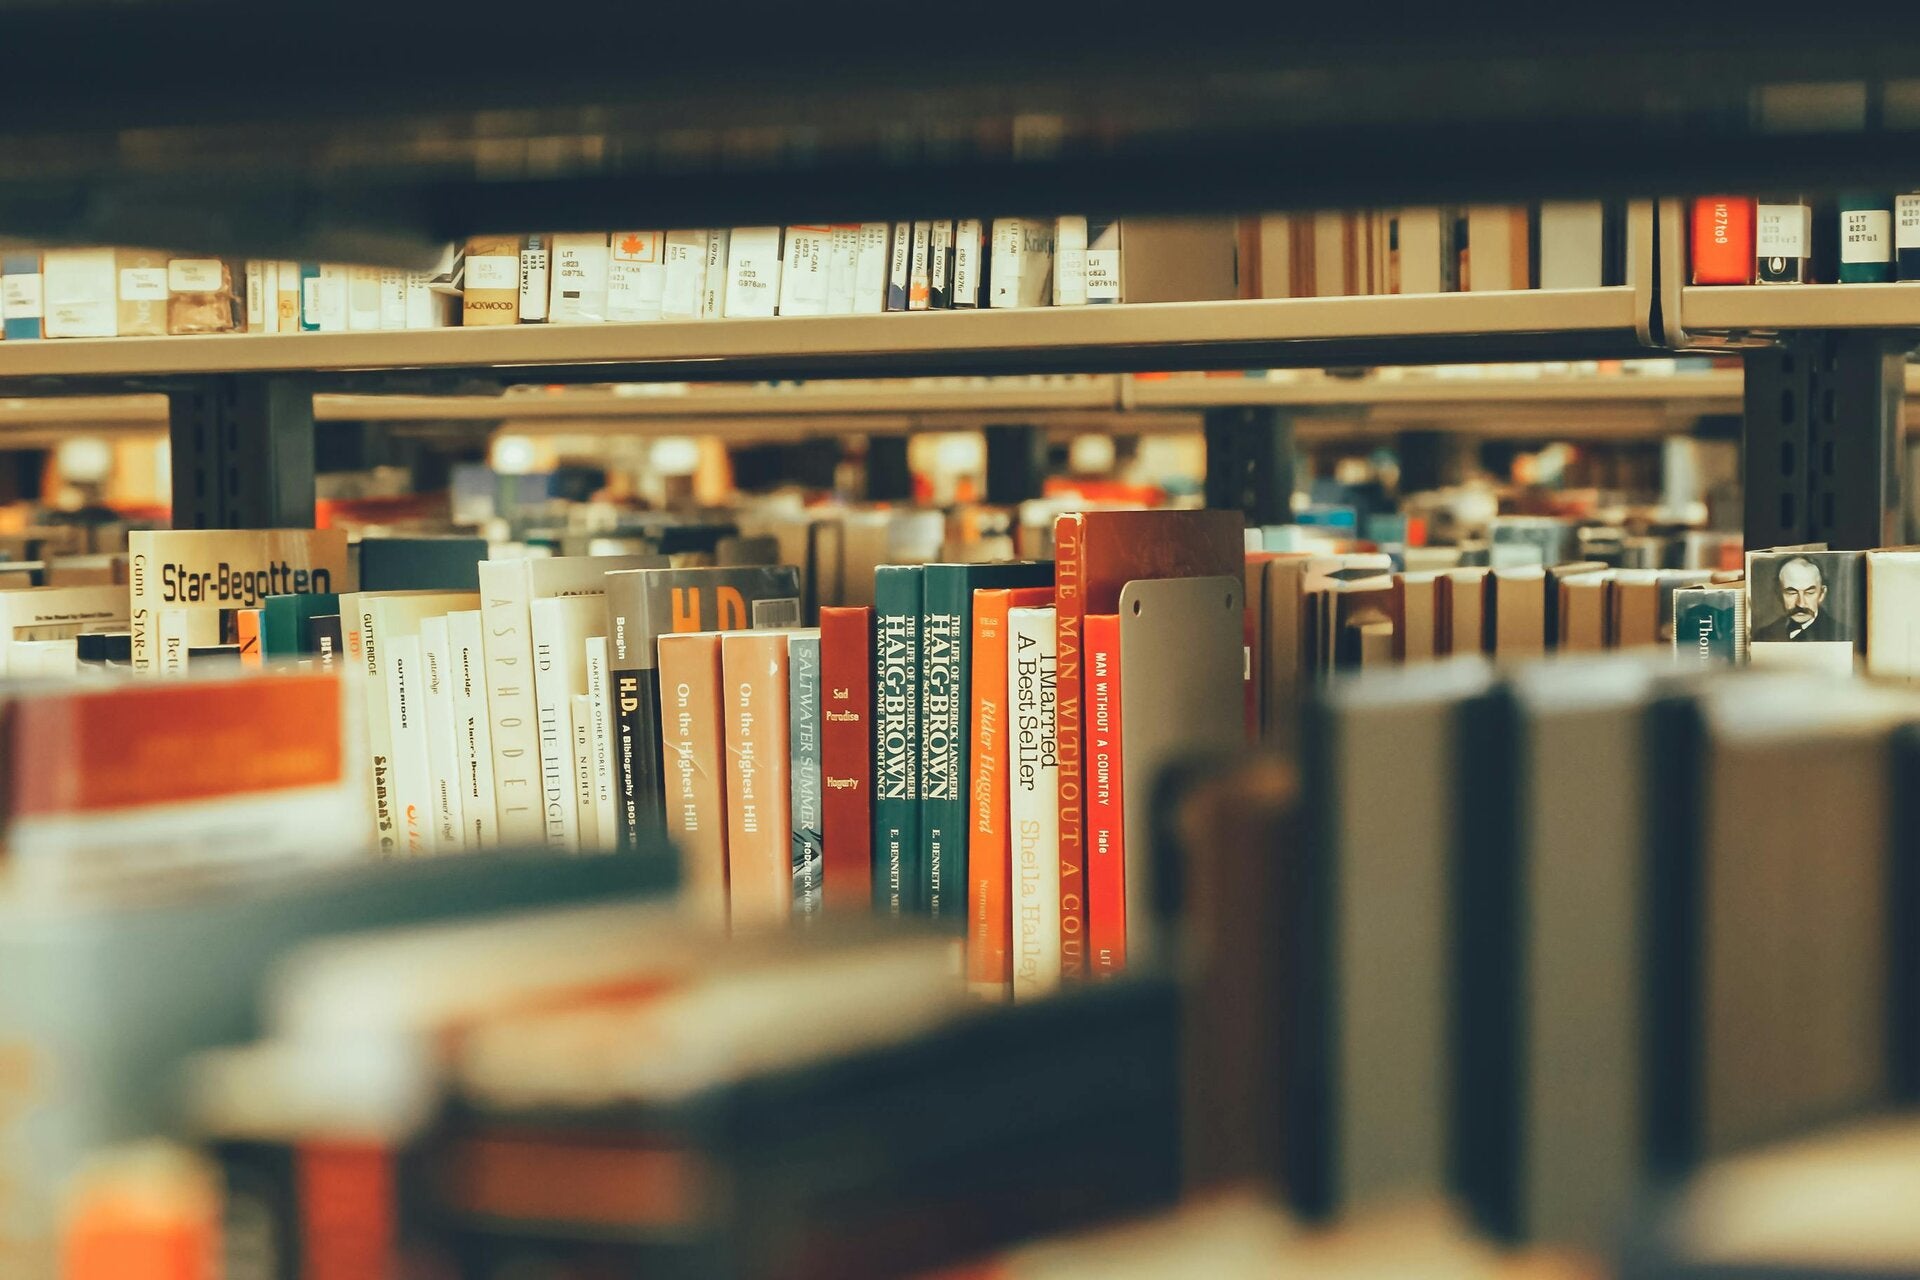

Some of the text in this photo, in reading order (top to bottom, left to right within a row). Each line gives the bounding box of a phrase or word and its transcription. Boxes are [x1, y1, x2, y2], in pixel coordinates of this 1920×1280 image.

[136, 554, 146, 596] Gunn
[163, 560, 330, 606] Star-Begotten
[1059, 536, 1077, 599] THE
[364, 613, 377, 676] GUTTERIDGE
[616, 617, 627, 659] Boughn
[1060, 616, 1078, 680] MAN
[427, 652, 440, 694] gutteridge
[463, 648, 471, 697] Gutteridge
[1096, 652, 1108, 677] MAN
[398, 659, 408, 729] GUTTERIDGE
[490, 599, 528, 815] ASPHODEL
[592, 658, 601, 698] NARTHEX
[598, 743, 606, 776] STORIES
[619, 678, 638, 716] H.D.
[799, 648, 813, 752] SALTWATER
[826, 711, 860, 722] Paradise
[833, 688, 848, 699] Sad
[877, 614, 886, 800] A MAN OF SOME IMPORTANCE
[886, 614, 906, 800] HAIG-BROWN
[906, 615, 916, 800] THE LIFE OF RODERICK LANGMERE
[922, 614, 930, 800] A MAN OF SOME IMPORTANCE
[929, 614, 950, 800] HAIG-BROWN
[949, 615, 960, 800] THE LIFE OF RODERICK LANGMERE
[1040, 653, 1060, 770] I Married
[1096, 683, 1108, 732] WITHOUT
[468, 717, 476, 758] Winter's
[542, 704, 557, 746] THE
[980, 698, 996, 749] Rider
[580, 756, 589, 804] NIGHTS
[622, 736, 634, 796] Bibliography
[677, 683, 698, 831] On the Highest Hill
[739, 683, 757, 832] On the Highest Hill
[1060, 697, 1079, 847] WITHOUT
[1097, 754, 1109, 806] COUNTRY
[800, 757, 814, 830] SUMMER
[976, 754, 994, 834] Haggard
[1018, 632, 1041, 984] A Best Seller Sheila Hailey
[890, 829, 899, 838] E.
[932, 829, 940, 838] E.
[1098, 830, 1110, 854] Hale
[804, 842, 812, 888] RODERICK
[890, 842, 899, 892] BENNETT
[932, 842, 941, 892] BENNETT
[1061, 860, 1079, 878] A
[979, 880, 988, 920] Norman
[1100, 949, 1111, 966] LIT
